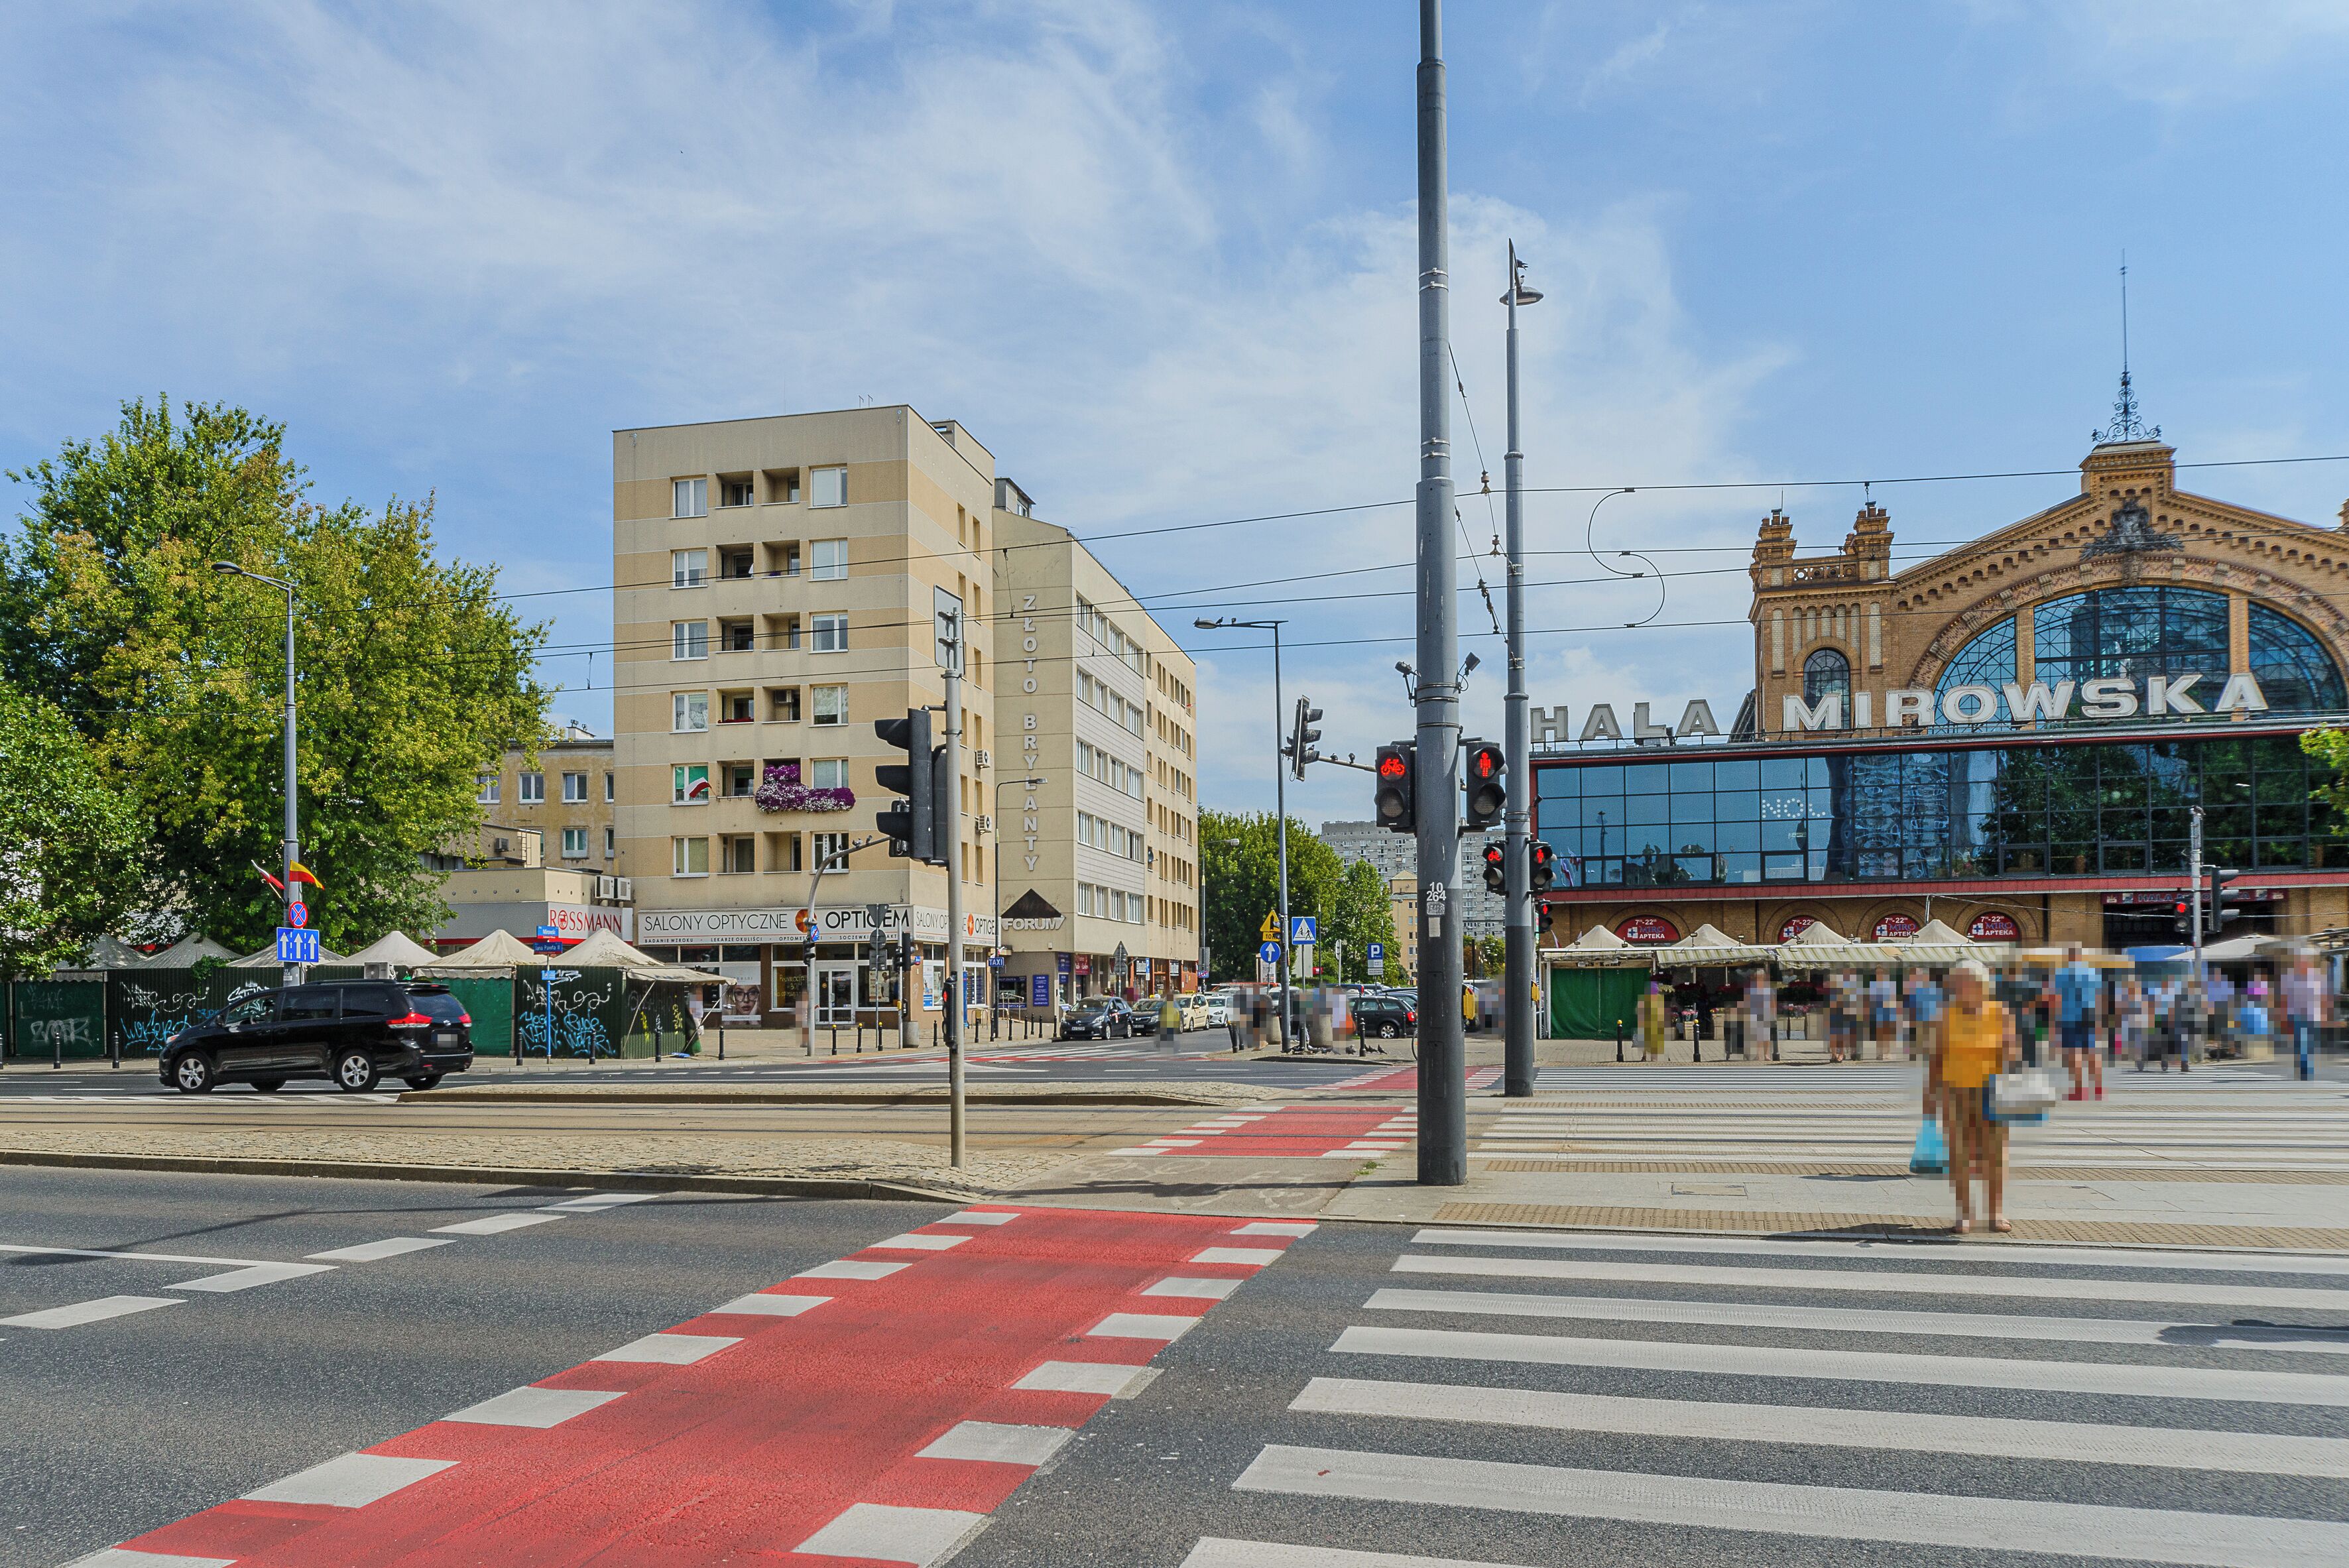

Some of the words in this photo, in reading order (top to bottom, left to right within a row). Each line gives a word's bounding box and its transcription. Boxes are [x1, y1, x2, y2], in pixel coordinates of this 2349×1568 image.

[1023, 595, 1038, 693] ZŁOTO
[1530, 699, 1720, 743] HALA
[1782, 672, 2268, 731] MIROWSKA
[1023, 715, 1039, 871] BRYLANTY
[1429, 881, 1443, 892] 10
[1426, 890, 1447, 902] 264
[2138, 893, 2173, 902] HALA
[550, 909, 622, 934] ROSSMANN
[644, 915, 703, 931] SALONY
[707, 913, 788, 930] OPTYCZNE
[916, 911, 939, 928] SALONY
[975, 918, 996, 935] OPTIGE
[1000, 917, 1065, 930] FORUM
